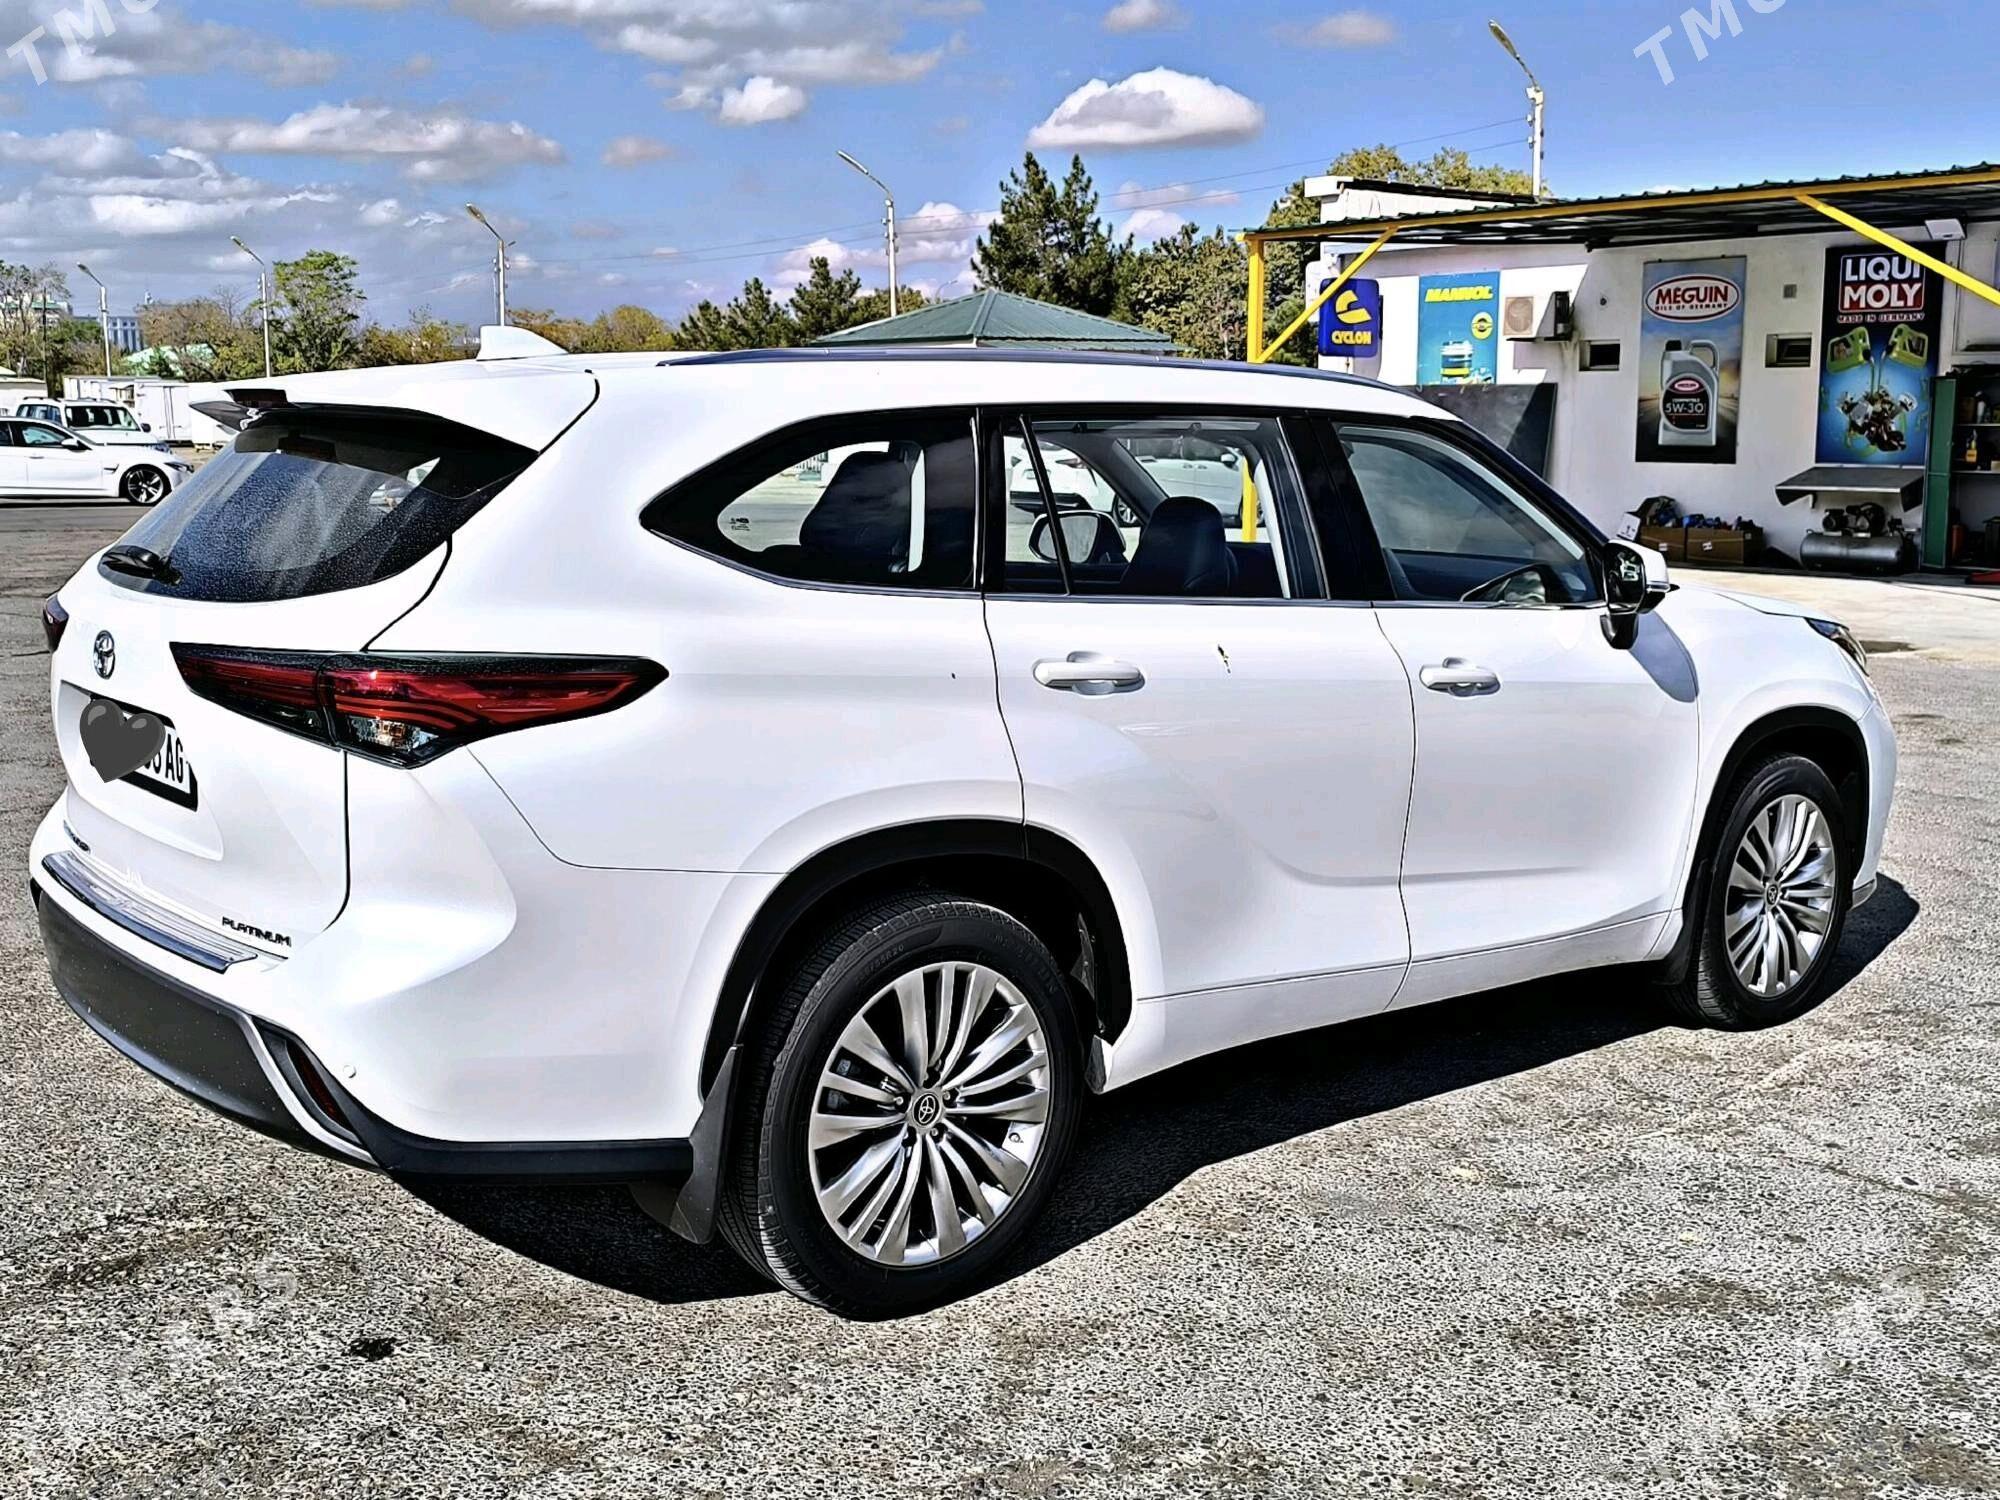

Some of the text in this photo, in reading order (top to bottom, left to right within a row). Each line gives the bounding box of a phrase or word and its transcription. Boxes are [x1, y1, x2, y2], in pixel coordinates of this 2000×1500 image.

[1845, 256, 1920, 281] LIQUI
[1424, 286, 1494, 302] MANNOL
[1843, 283, 1922, 309] MOLY
[1689, 303, 1728, 311] GERMANY
[1878, 312, 1925, 323] GERMANY
[1331, 330, 1372, 345] CYCLON
[1664, 402, 1704, 414] 5W-30
[222, 916, 292, 948] PLATINUM
